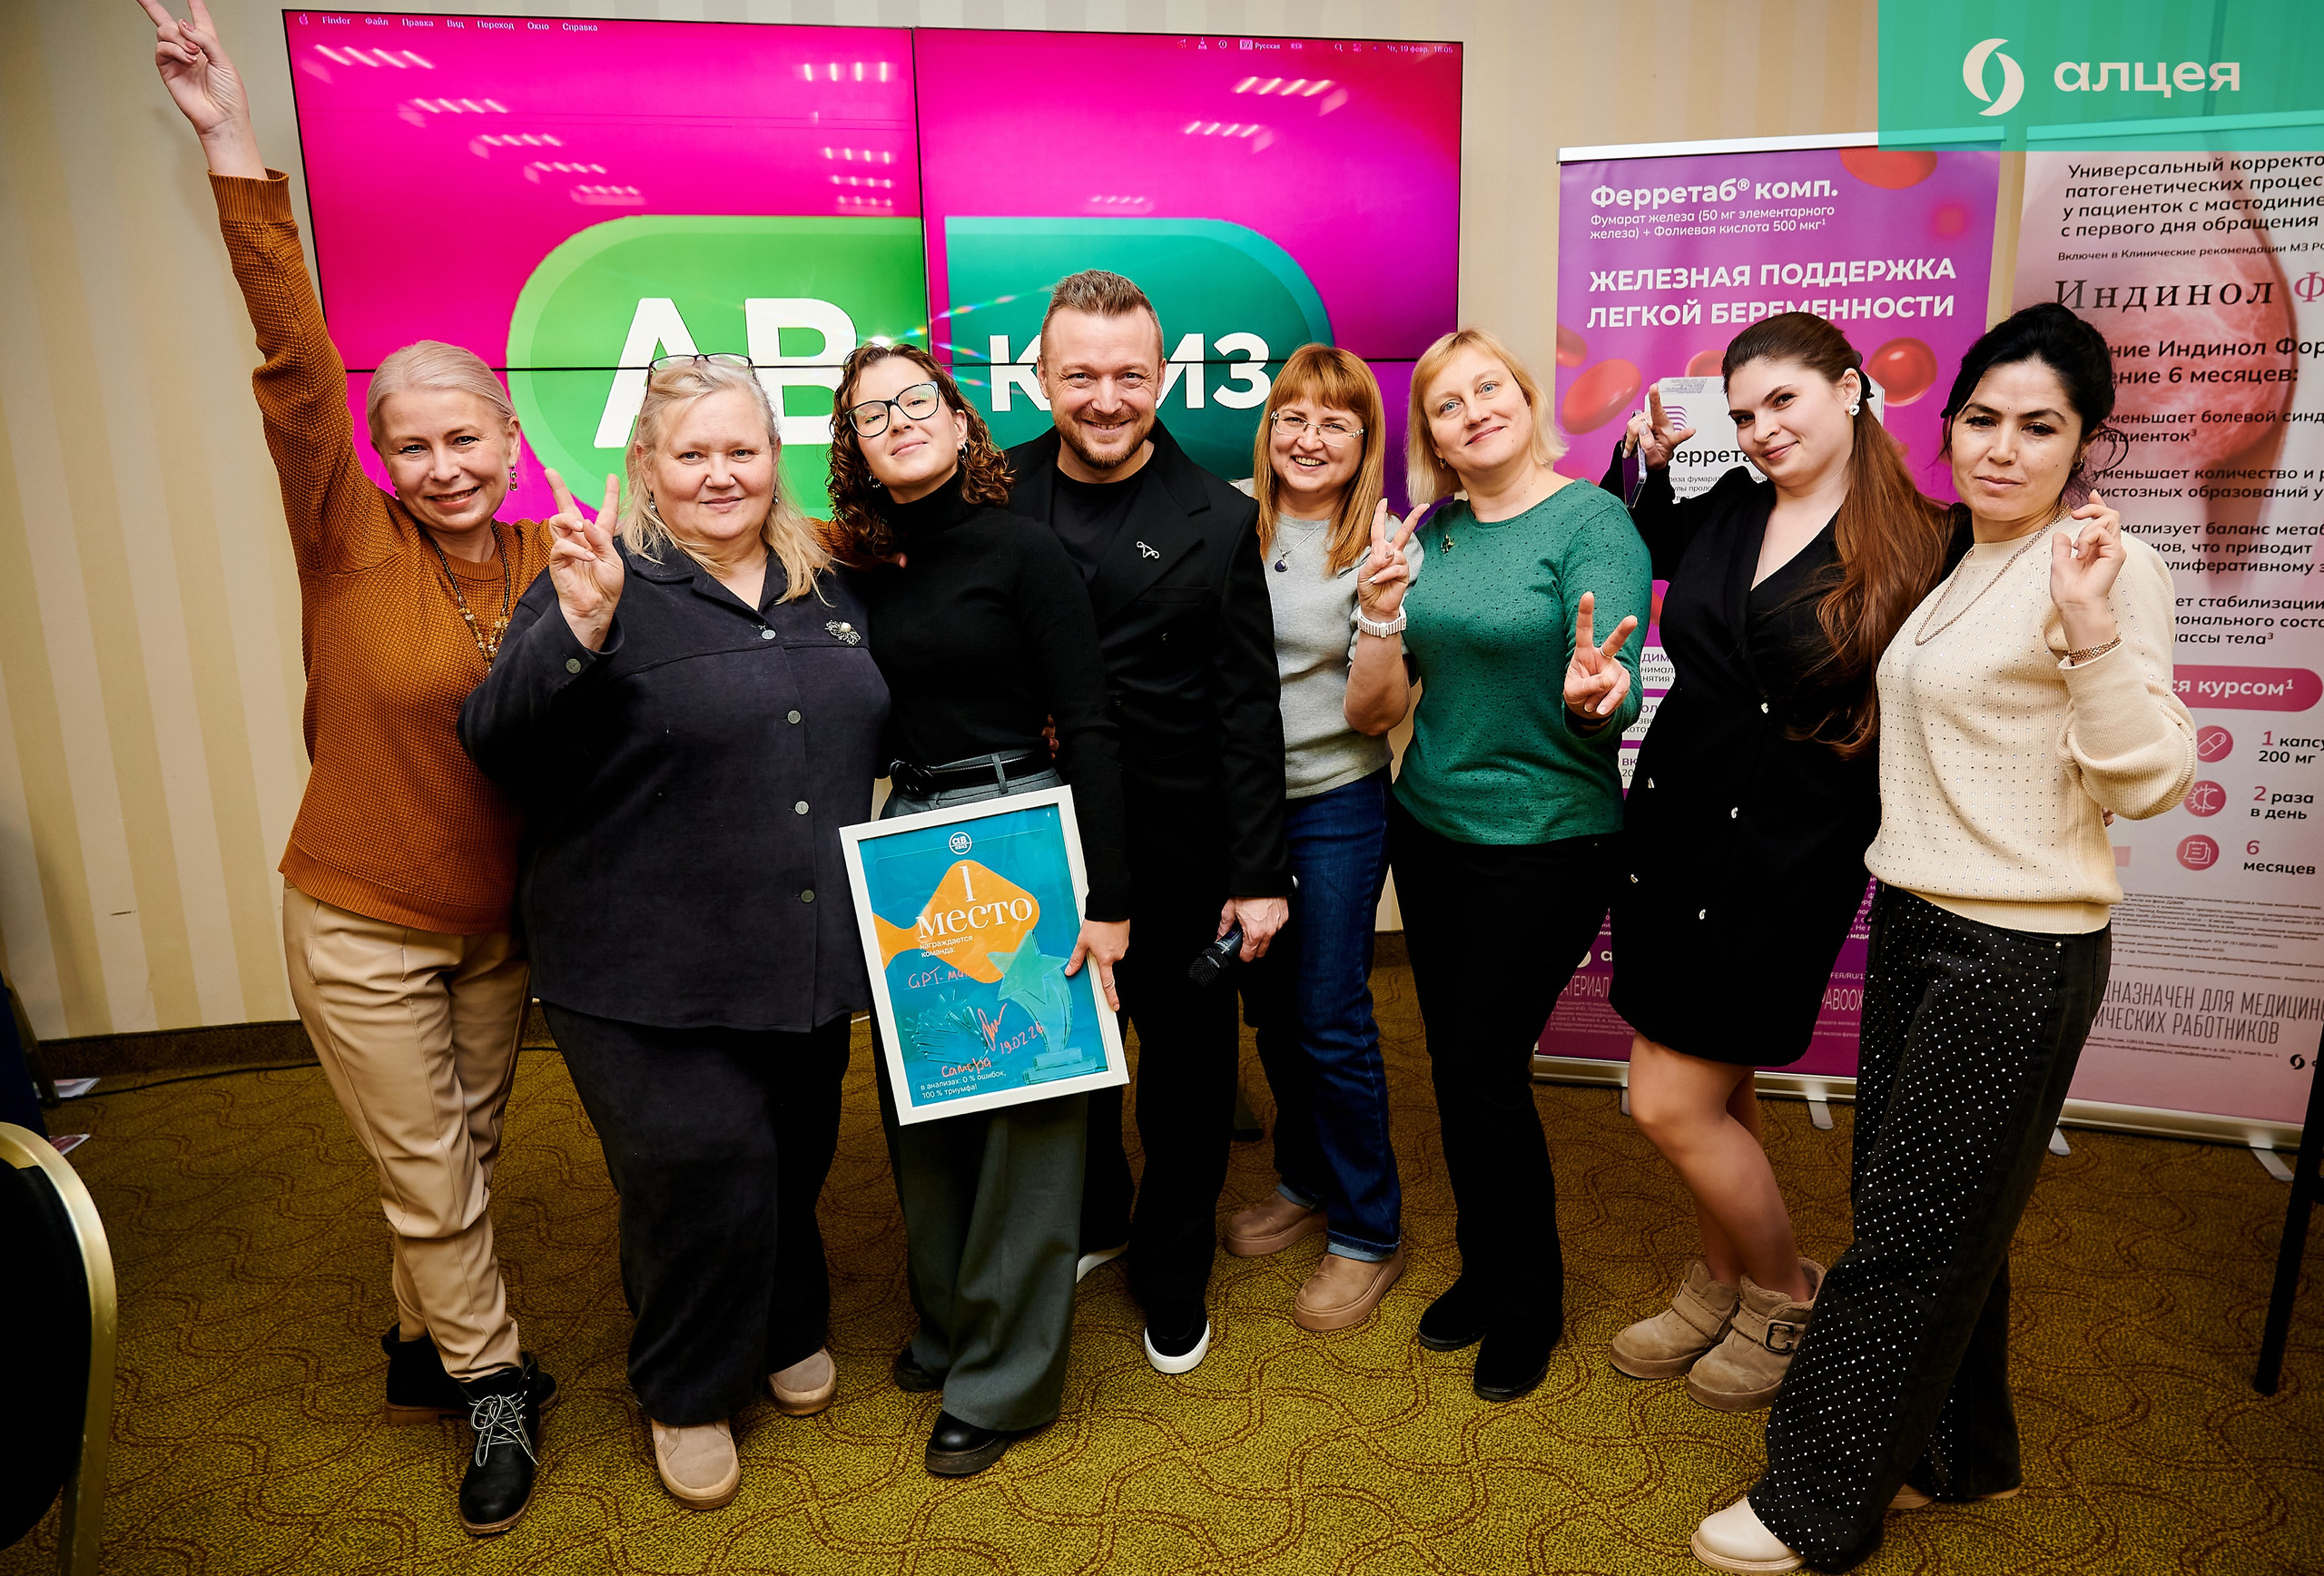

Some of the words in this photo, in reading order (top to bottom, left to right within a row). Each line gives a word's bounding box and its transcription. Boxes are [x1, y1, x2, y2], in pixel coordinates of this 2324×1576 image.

[321, 15, 351, 25] Finder
[365, 17, 389, 26] Файл
[401, 18, 434, 28] Правка
[447, 19, 465, 29] Вид
[477, 20, 515, 30] Переход
[527, 22, 550, 30] Окно
[562, 23, 598, 32] Справка
[1255, 43, 1281, 51] Русская
[2068, 157, 2224, 180] Универсальный
[2230, 155, 2324, 173] корректо
[1755, 180, 1838, 200] комп.
[2065, 179, 2243, 198] патогенетических
[2250, 175, 2324, 192] процес
[1590, 214, 1647, 228] Фумарат
[1649, 212, 1695, 223] железа
[1699, 209, 1718, 223] (50
[1720, 211, 1736, 220] мг
[1738, 206, 1835, 220] элементарного
[2063, 207, 2073, 222] у
[2079, 202, 2183, 218] пациенток
[2189, 201, 2199, 212] с
[1590, 227, 1640, 240] железа)
[1654, 225, 1716, 237] Фолиевая
[1719, 223, 1769, 234] кислота
[1773, 220, 1797, 231] 500
[2061, 226, 2071, 237] с
[2076, 222, 2154, 239] первого
[2160, 222, 2196, 235] дня
[2202, 216, 2319, 234] обращения
[2058, 251, 2108, 261] Включен
[2121, 248, 2196, 258] Клинические
[2200, 245, 2287, 257] рекомендации
[2290, 242, 2309, 252] МЗ
[1589, 264, 1750, 292] ЖЕЛЕЗНАЯ
[1760, 258, 1956, 289] ПОДДЕРЖКА
[2055, 279, 2275, 313] Индинол
[1586, 299, 1701, 329] ЛЕГКОЙ
[1710, 295, 1955, 324] БЕРЕМЕННОСТИ
[2158, 340, 2266, 360] Индинол
[990, 332, 1272, 412] КИЗ
[2169, 367, 2182, 383] 6
[2190, 369, 2299, 385] месяцев:
[2105, 414, 2197, 424] меньшает
[2201, 409, 2276, 424] болевой
[2093, 468, 2190, 482] уменьшает
[2194, 468, 2298, 479] количество
[2304, 469, 2314, 479] и
[2188, 485, 2308, 500] образований
[2313, 488, 2324, 501] у
[2205, 522, 2270, 536] баланс
[2191, 543, 2221, 554] что
[2225, 543, 2313, 557] приводит
[2198, 596, 2324, 612] стабилизации
[2175, 633, 2221, 644] ассы
[2262, 730, 2274, 746] 1
[2258, 750, 2290, 763] 200
[2295, 754, 2316, 764] мг
[2253, 785, 2267, 802] 2
[2271, 793, 2314, 805] раза
[2250, 808, 2260, 817] в
[2264, 808, 2308, 820] день
[2246, 840, 2260, 855] 6
[2243, 862, 2316, 876] месяцев
[920, 935, 973, 950] награждается
[921, 947, 956, 958] команда:
[1830, 971, 1866, 980] FER/RU/1
[1822, 988, 1865, 1011] АВООХ
[2200, 988, 2234, 1013] ДЛЯ
[2172, 1012, 2280, 1045] РАБОТНИКОВ
[927, 1078, 961, 1088] анализах:
[962, 1076, 968, 1084] 0
[977, 1070, 1007, 1080] ошибок,
[922, 1091, 935, 1099] 100
[944, 1083, 978, 1096] триумфа!
